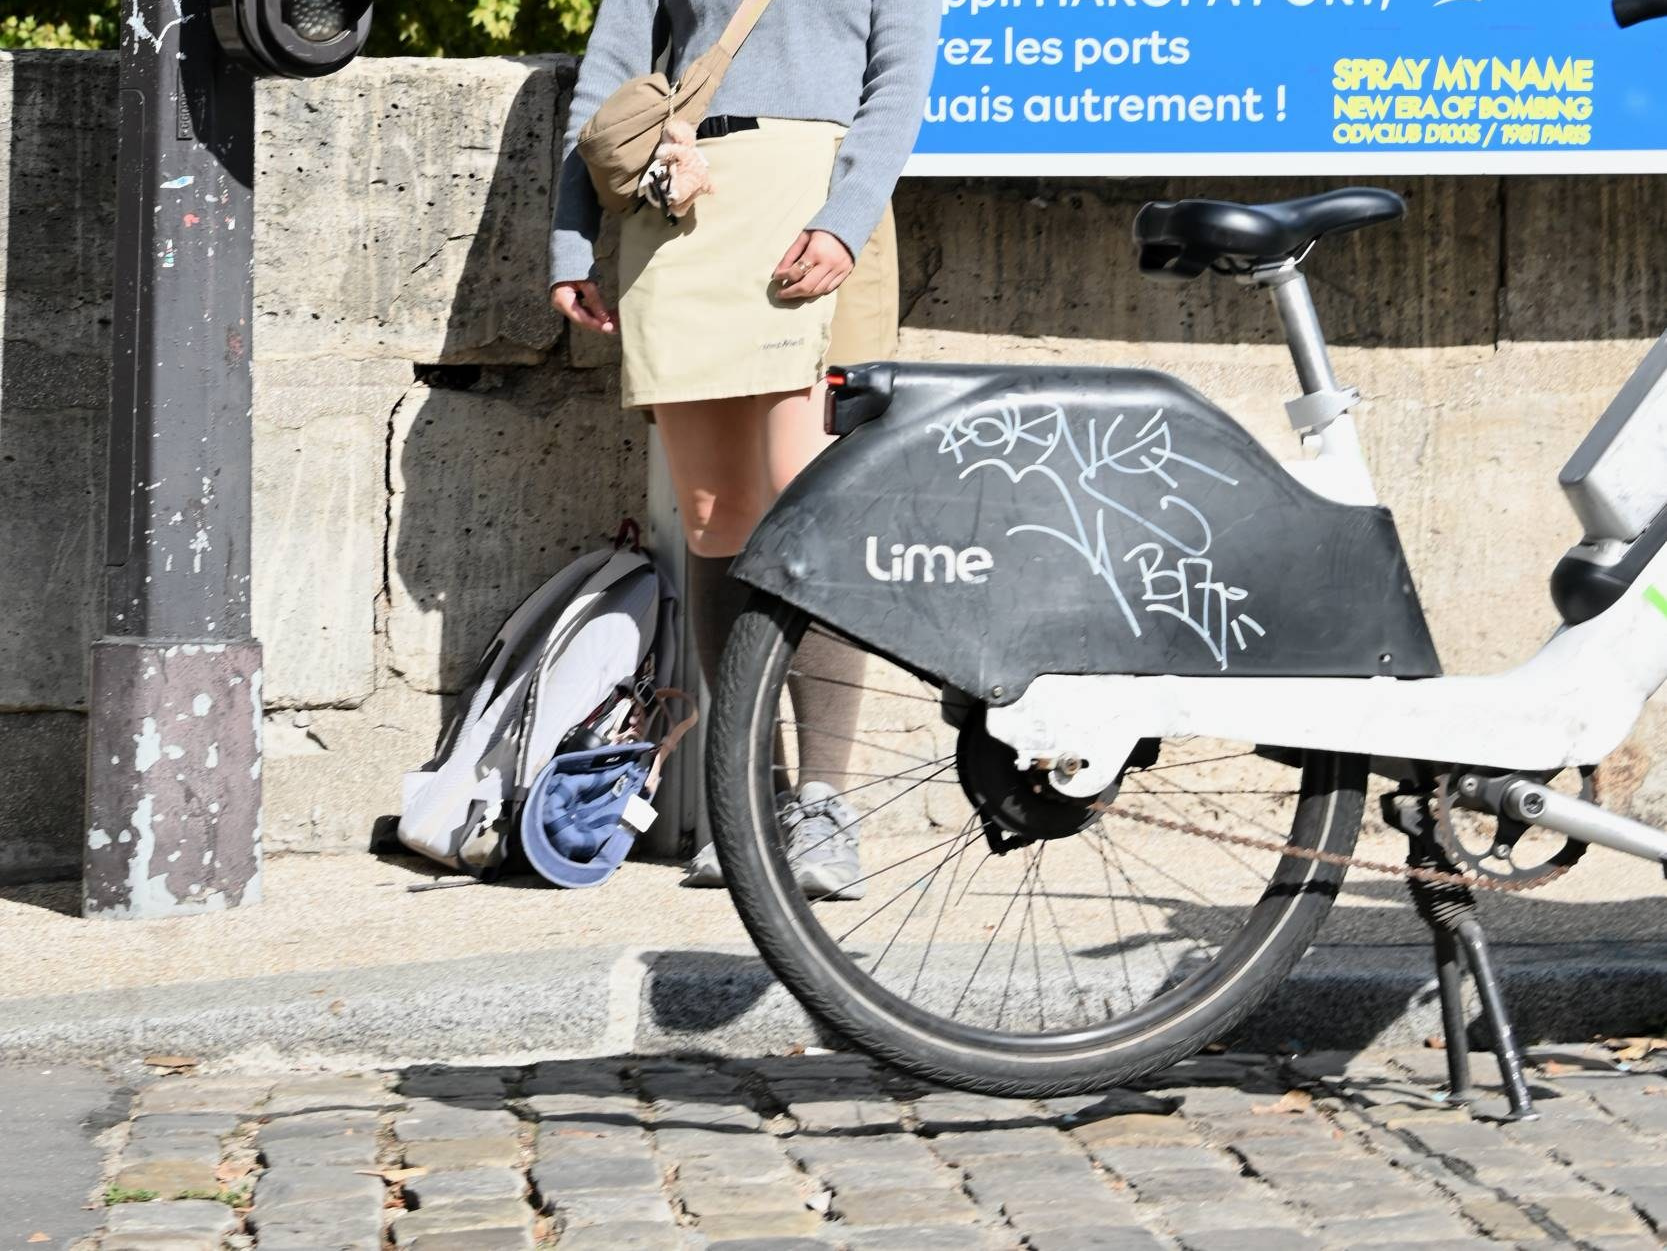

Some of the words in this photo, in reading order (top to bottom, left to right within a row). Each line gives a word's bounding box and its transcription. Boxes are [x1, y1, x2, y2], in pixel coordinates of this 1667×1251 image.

[1004, 27, 1063, 66] les
[1074, 30, 1191, 72] ports
[1332, 55, 1431, 91] SPRAY
[1432, 54, 1489, 92] MY
[1491, 54, 1594, 93] NAME
[923, 85, 1014, 123] uais
[1023, 87, 1264, 123] autrement
[1333, 94, 1393, 121] NEW
[1394, 94, 1441, 120] ERA
[1441, 95, 1476, 120] OF
[1540, 123, 1592, 145] PARIS
[865, 536, 994, 584] Lime
